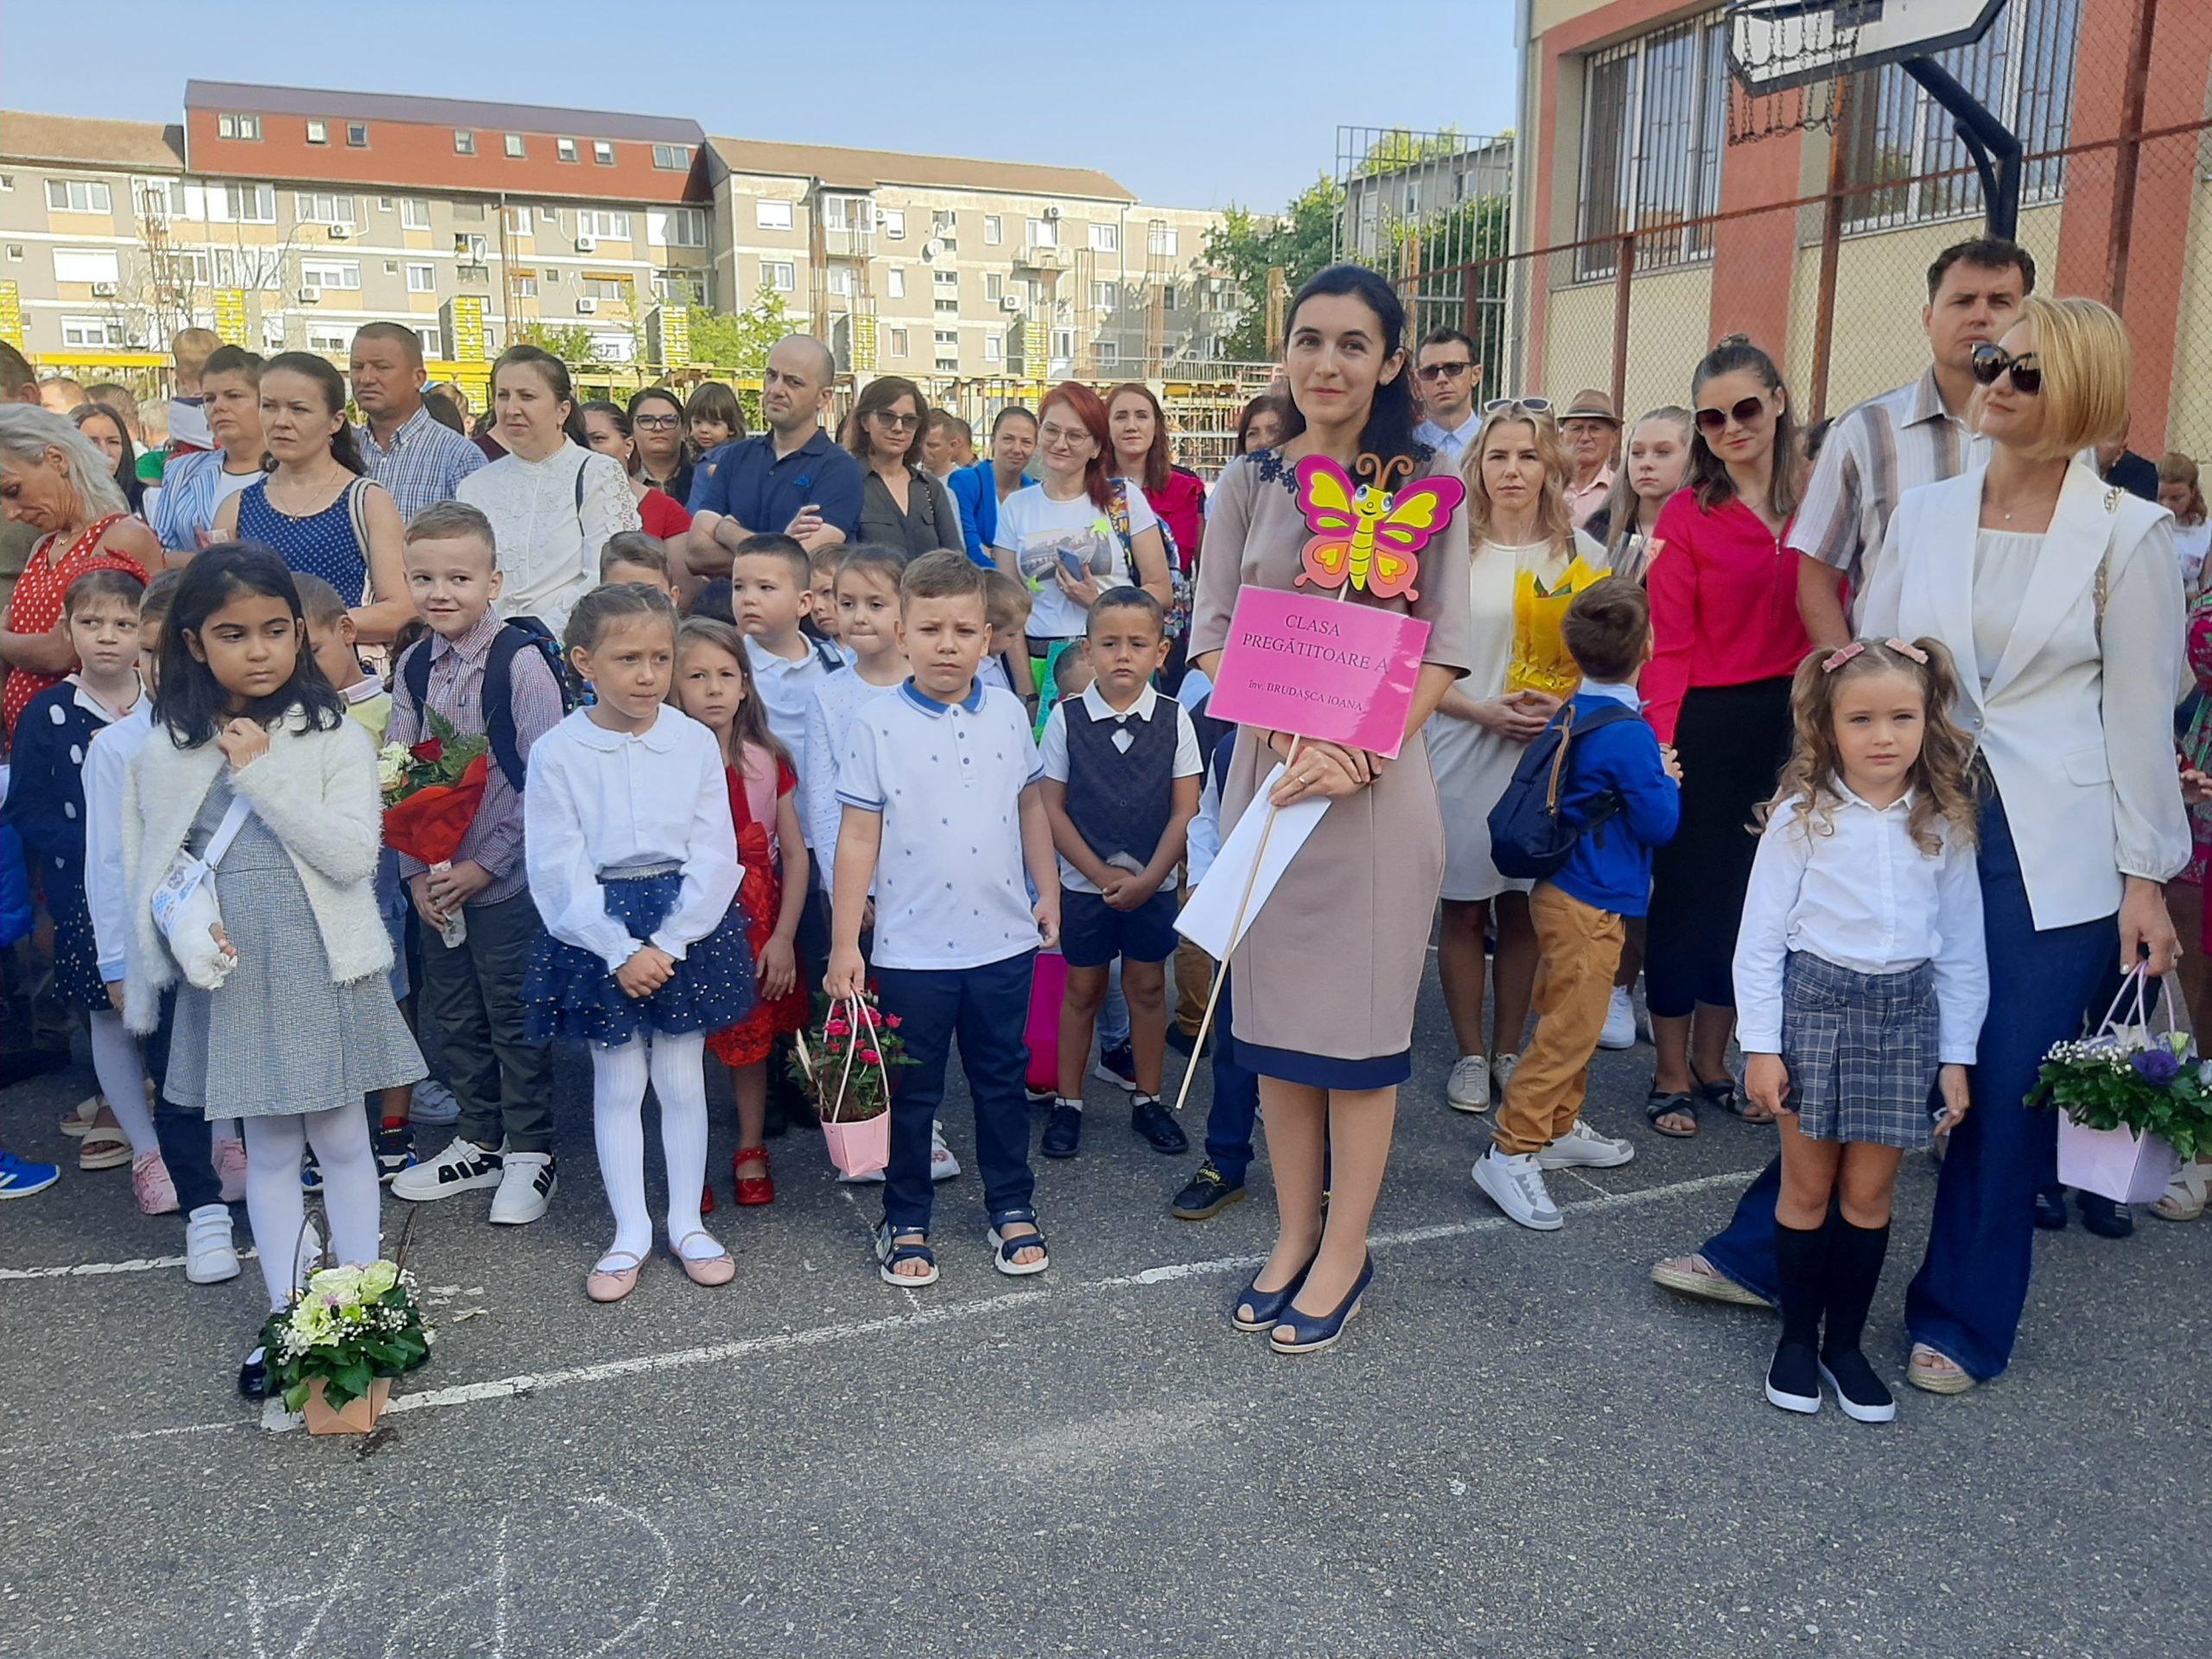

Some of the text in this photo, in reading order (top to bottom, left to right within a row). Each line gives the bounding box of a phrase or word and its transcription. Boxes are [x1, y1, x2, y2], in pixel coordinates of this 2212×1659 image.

[1285, 614, 1340, 637] CLASA
[1243, 632, 1389, 674] PREGĂTITOARE A
[1327, 696, 1363, 711] IOANA
